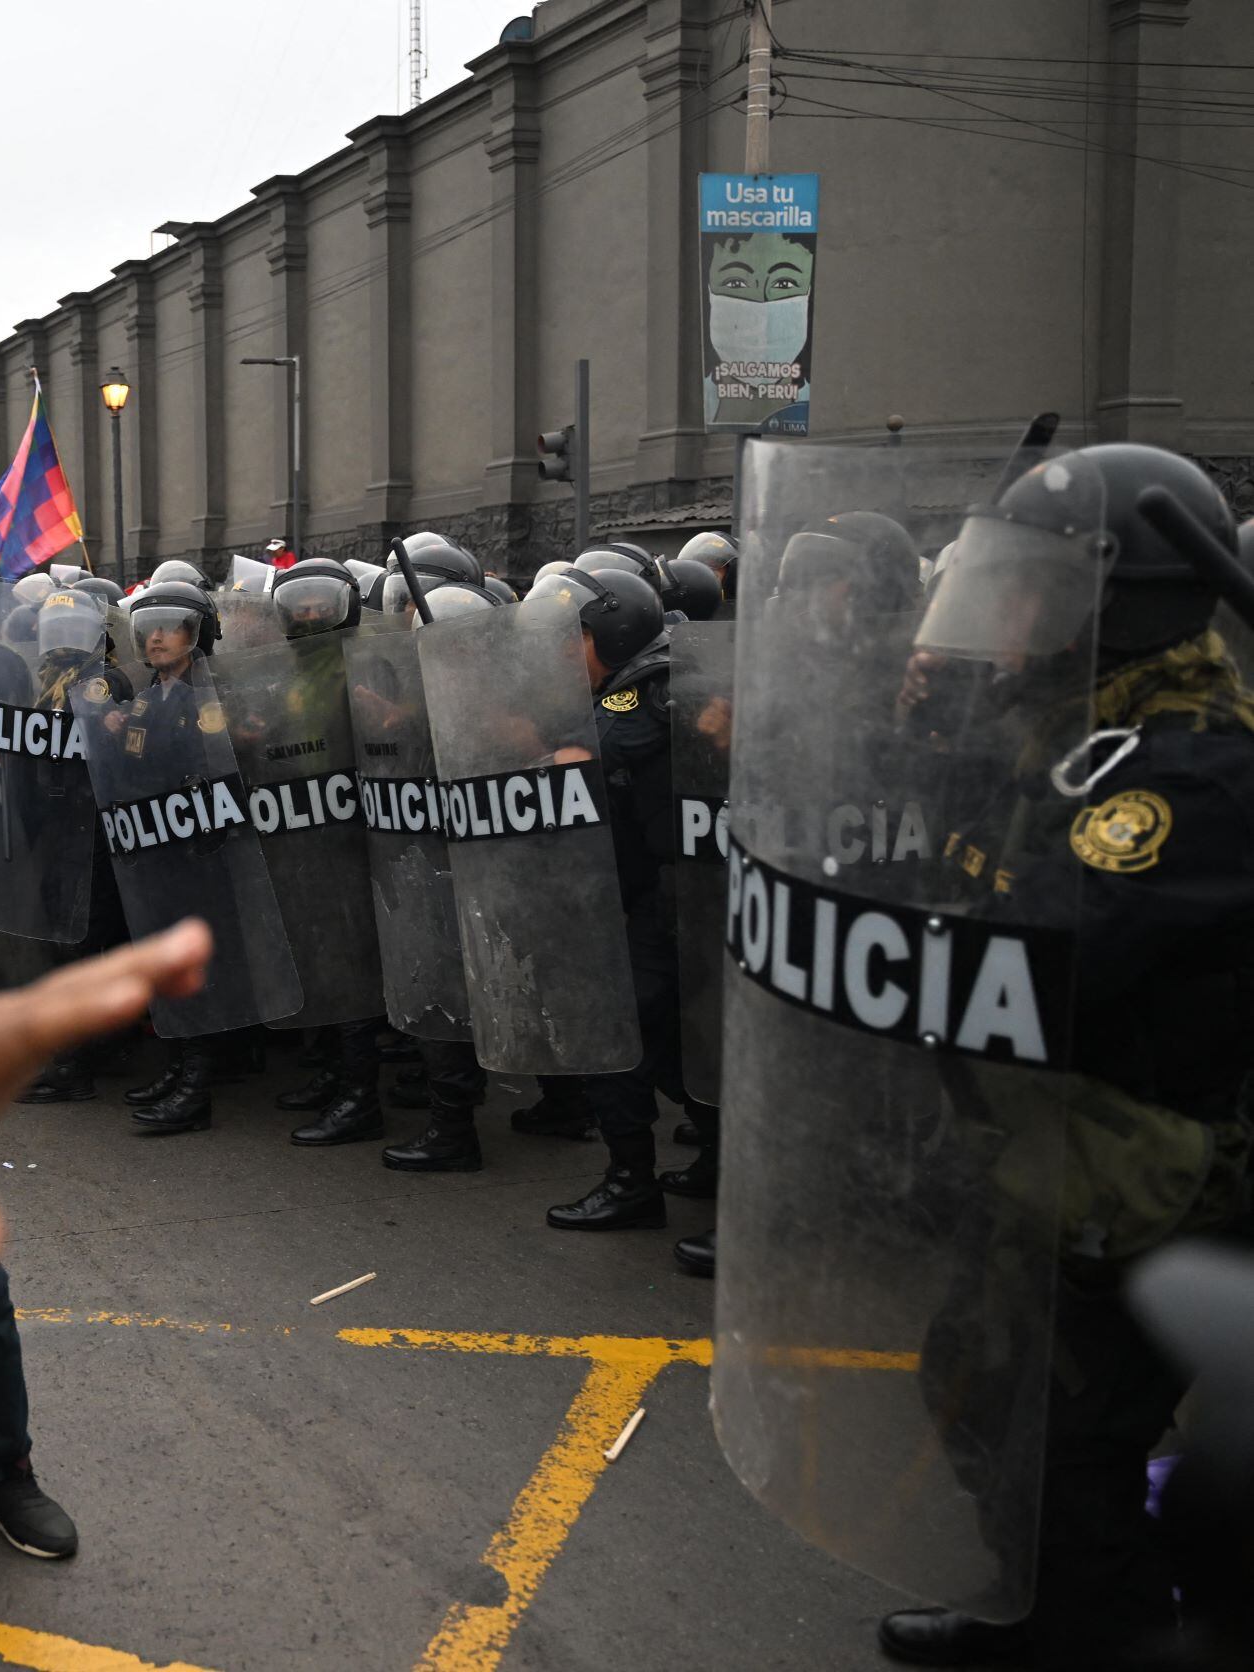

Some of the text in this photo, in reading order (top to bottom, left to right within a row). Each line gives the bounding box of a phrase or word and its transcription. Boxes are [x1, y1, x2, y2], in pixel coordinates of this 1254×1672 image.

[726, 182, 794, 203] Usa tu
[706, 206, 812, 226] mascarilla
[715, 362, 802, 380] ¡SALGAMOS
[717, 384, 754, 400] BIEN,
[783, 423, 807, 432] LIMA
[266, 738, 327, 760] SALVATAJE
[249, 773, 357, 834] OLIC
[439, 767, 601, 839] POLICIA
[101, 781, 246, 854] POLICIA
[727, 845, 1047, 1062] POLICIA
